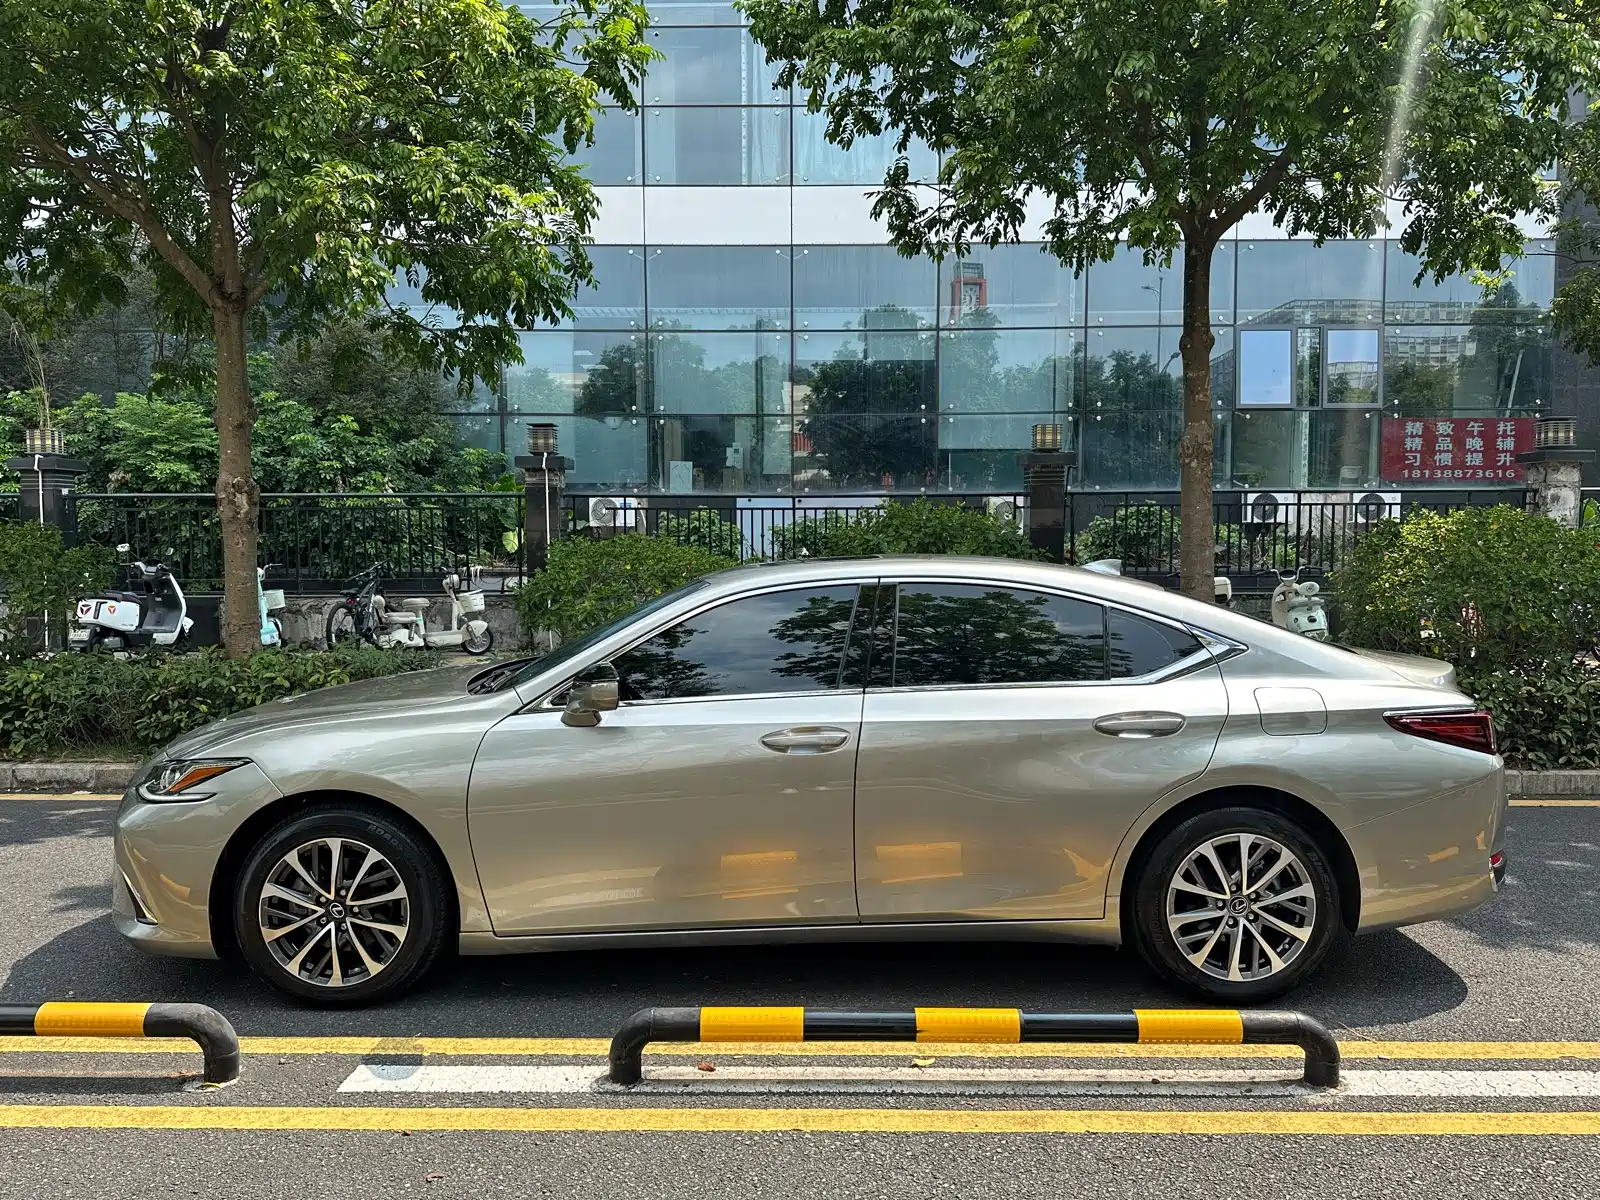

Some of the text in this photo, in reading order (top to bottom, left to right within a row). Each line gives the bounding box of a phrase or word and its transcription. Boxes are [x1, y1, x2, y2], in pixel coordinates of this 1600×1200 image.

[1405, 421, 1515, 435] 精致午托
[1404, 437, 1515, 450] 精品晚辅
[1404, 452, 1515, 466] 习惯提升
[1402, 469, 1515, 478] 18138873616
